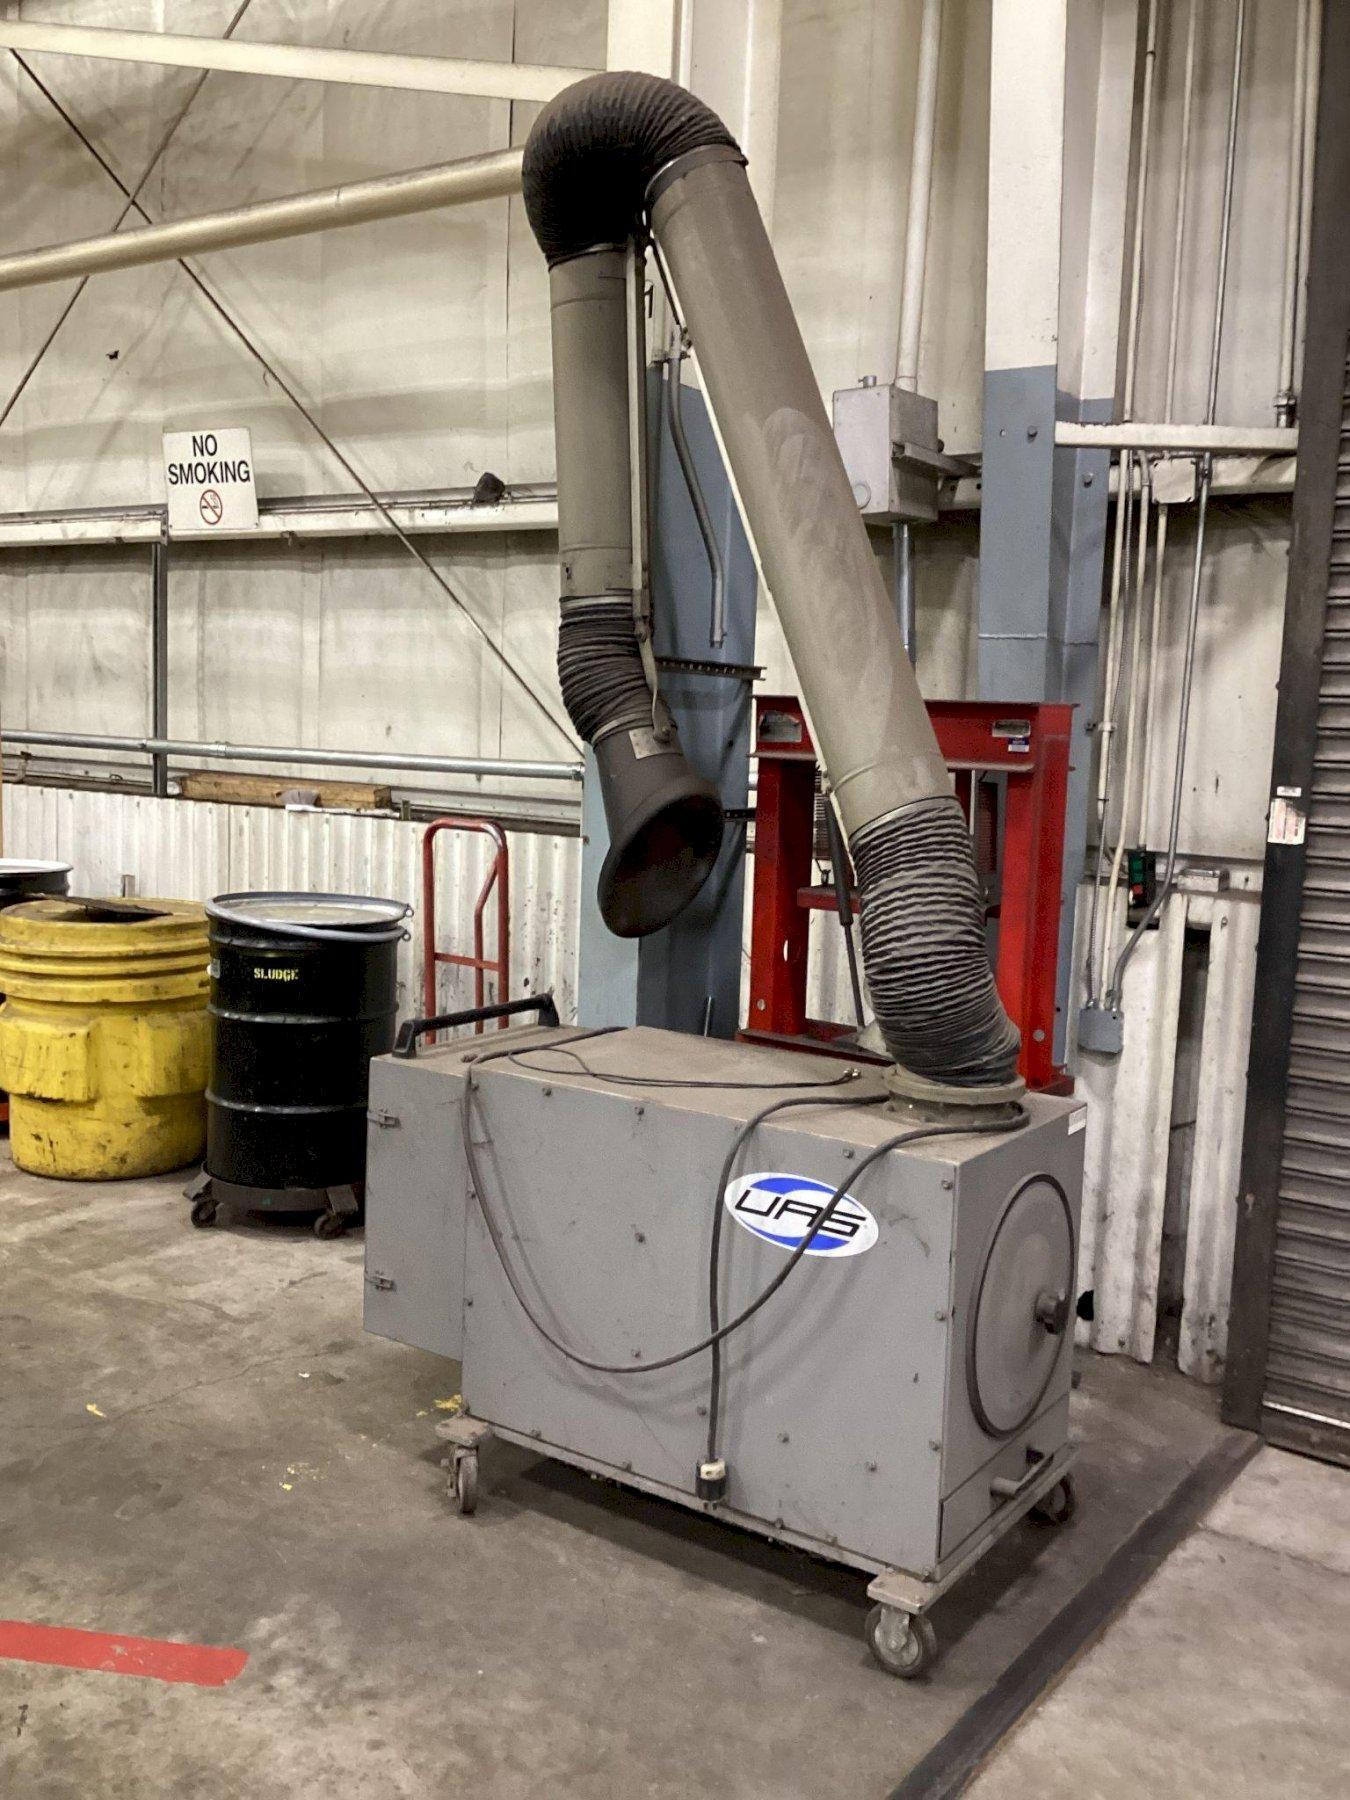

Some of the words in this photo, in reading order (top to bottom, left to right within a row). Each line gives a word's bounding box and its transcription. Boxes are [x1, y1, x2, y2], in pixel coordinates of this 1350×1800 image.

[192, 434, 218, 457] NO
[168, 460, 251, 485] SMOKING
[254, 967, 299, 982] SLUDGE
[735, 1189, 866, 1238] UAS
